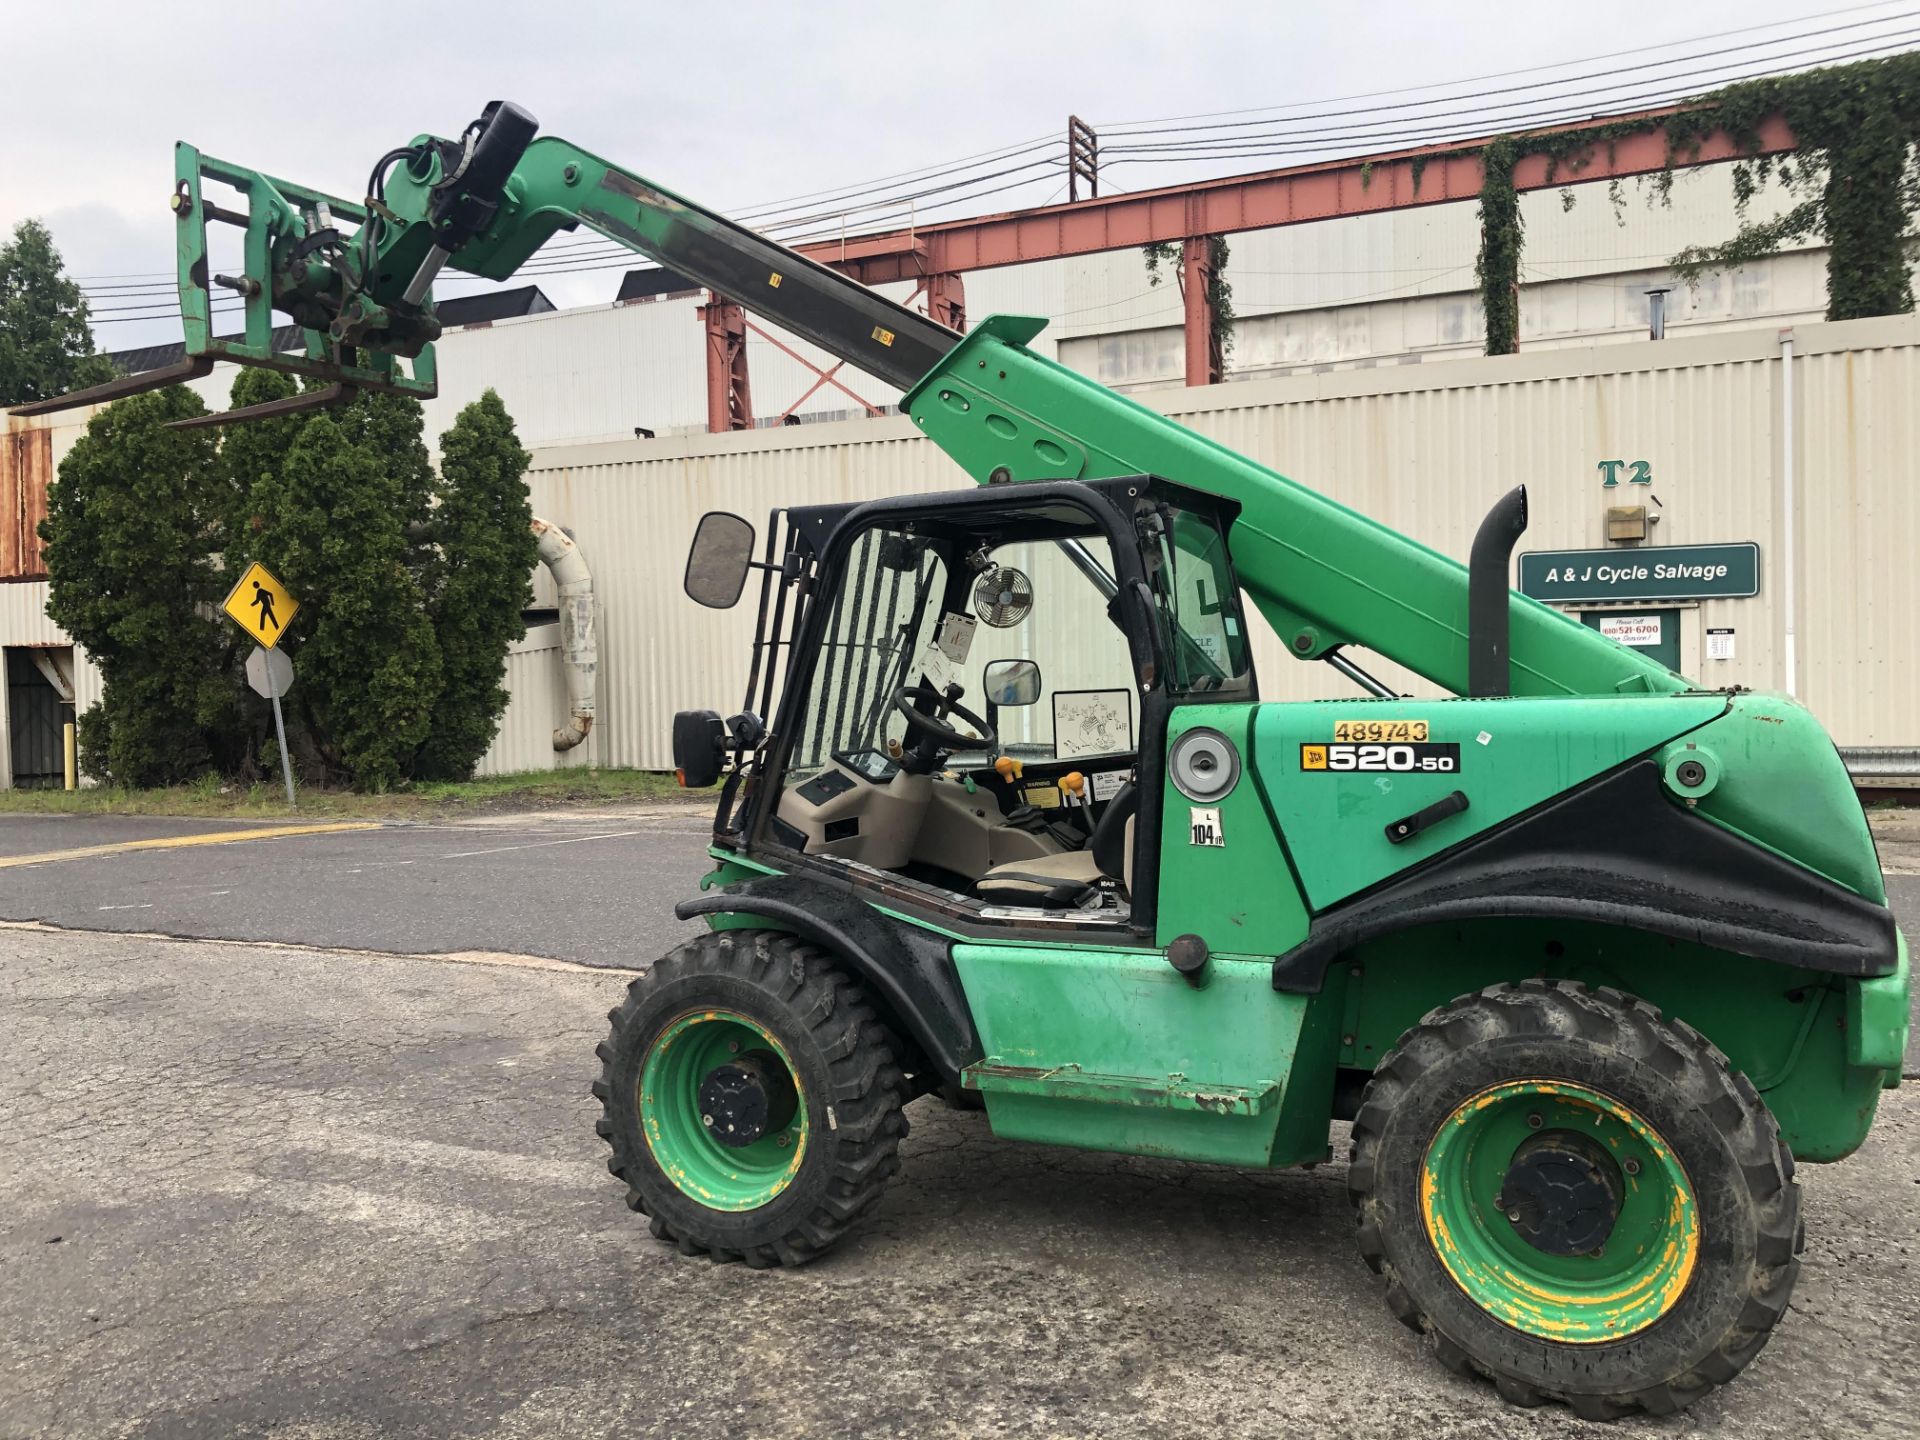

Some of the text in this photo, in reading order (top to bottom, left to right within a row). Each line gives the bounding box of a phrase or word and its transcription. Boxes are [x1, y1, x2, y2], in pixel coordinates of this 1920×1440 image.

[1545, 563, 1728, 584] A & J Cycle Salvage
[1336, 722, 1427, 742] 489743
[1309, 745, 1454, 771] JCB 520-50
[1192, 824, 1214, 845] 104
